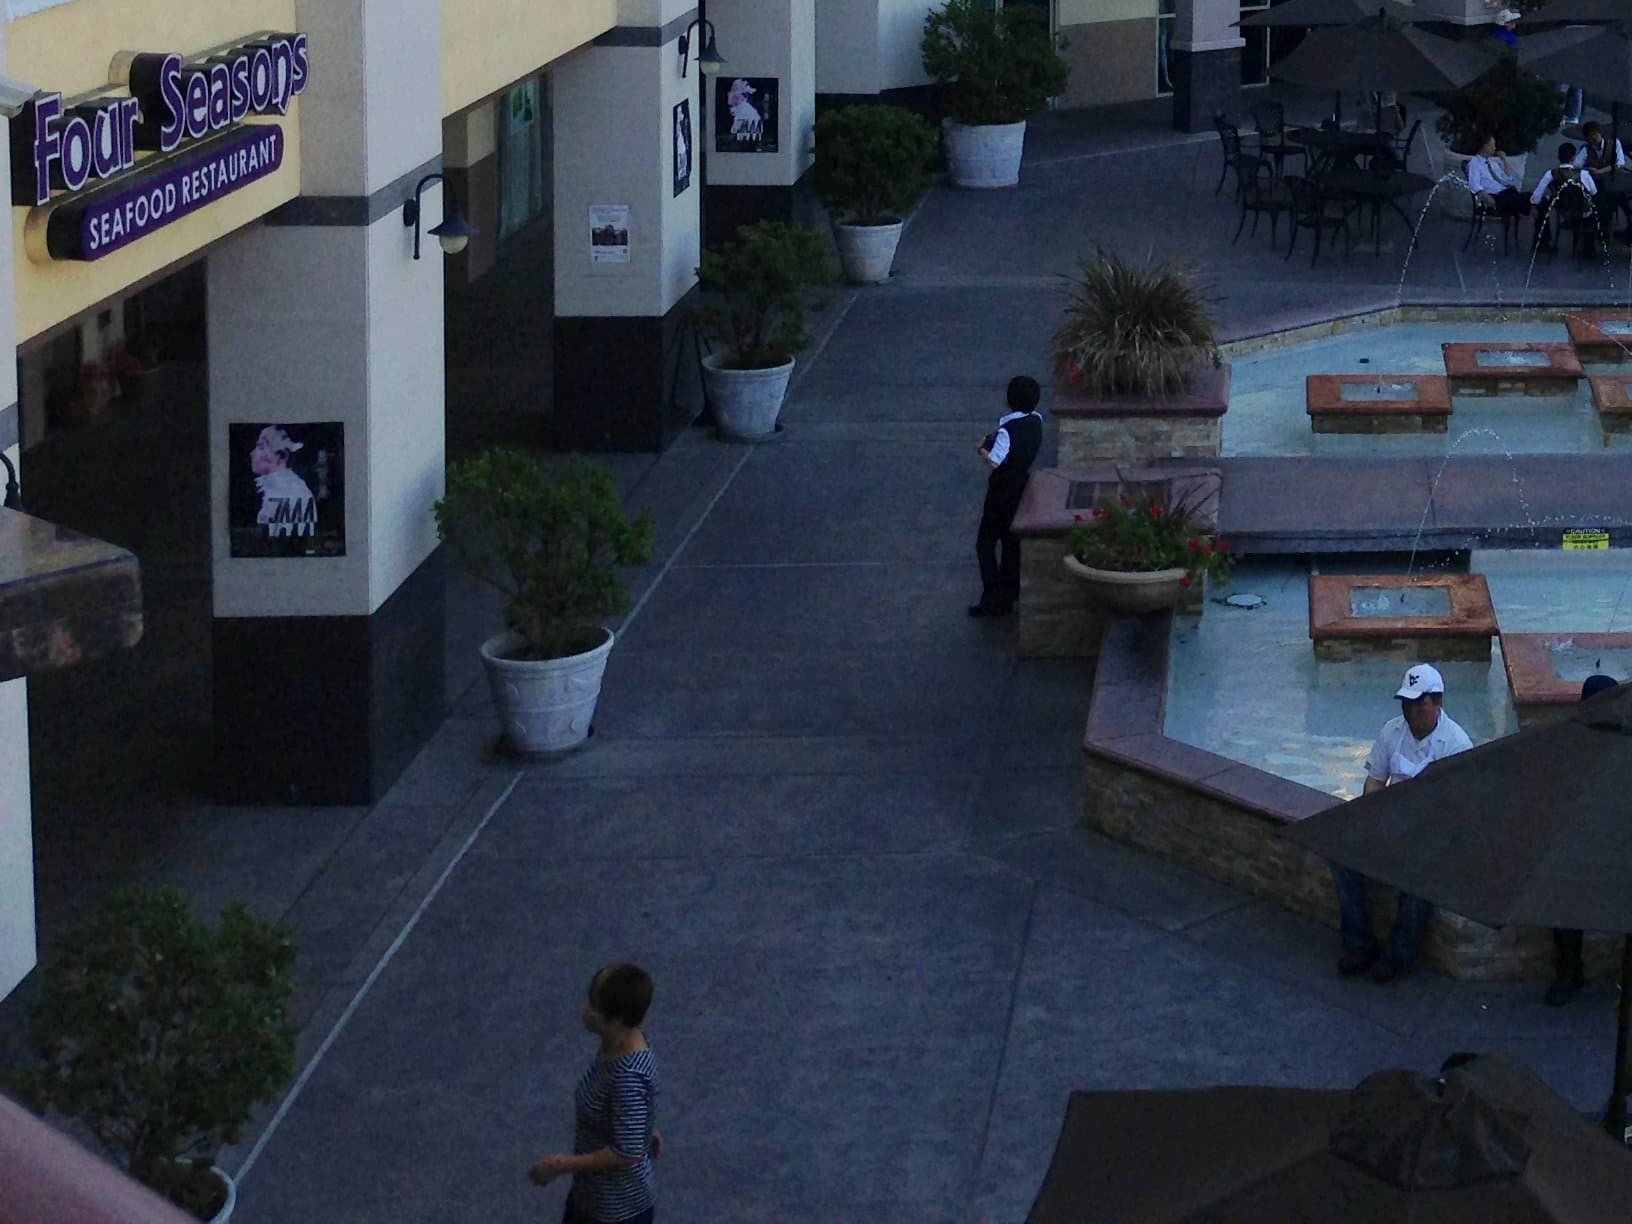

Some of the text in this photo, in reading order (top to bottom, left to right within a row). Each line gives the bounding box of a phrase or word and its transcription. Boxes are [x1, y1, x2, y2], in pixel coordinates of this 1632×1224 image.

[33, 31, 310, 206] Four Seasons
[88, 134, 278, 251] SEAFOOD RESTAURANT
